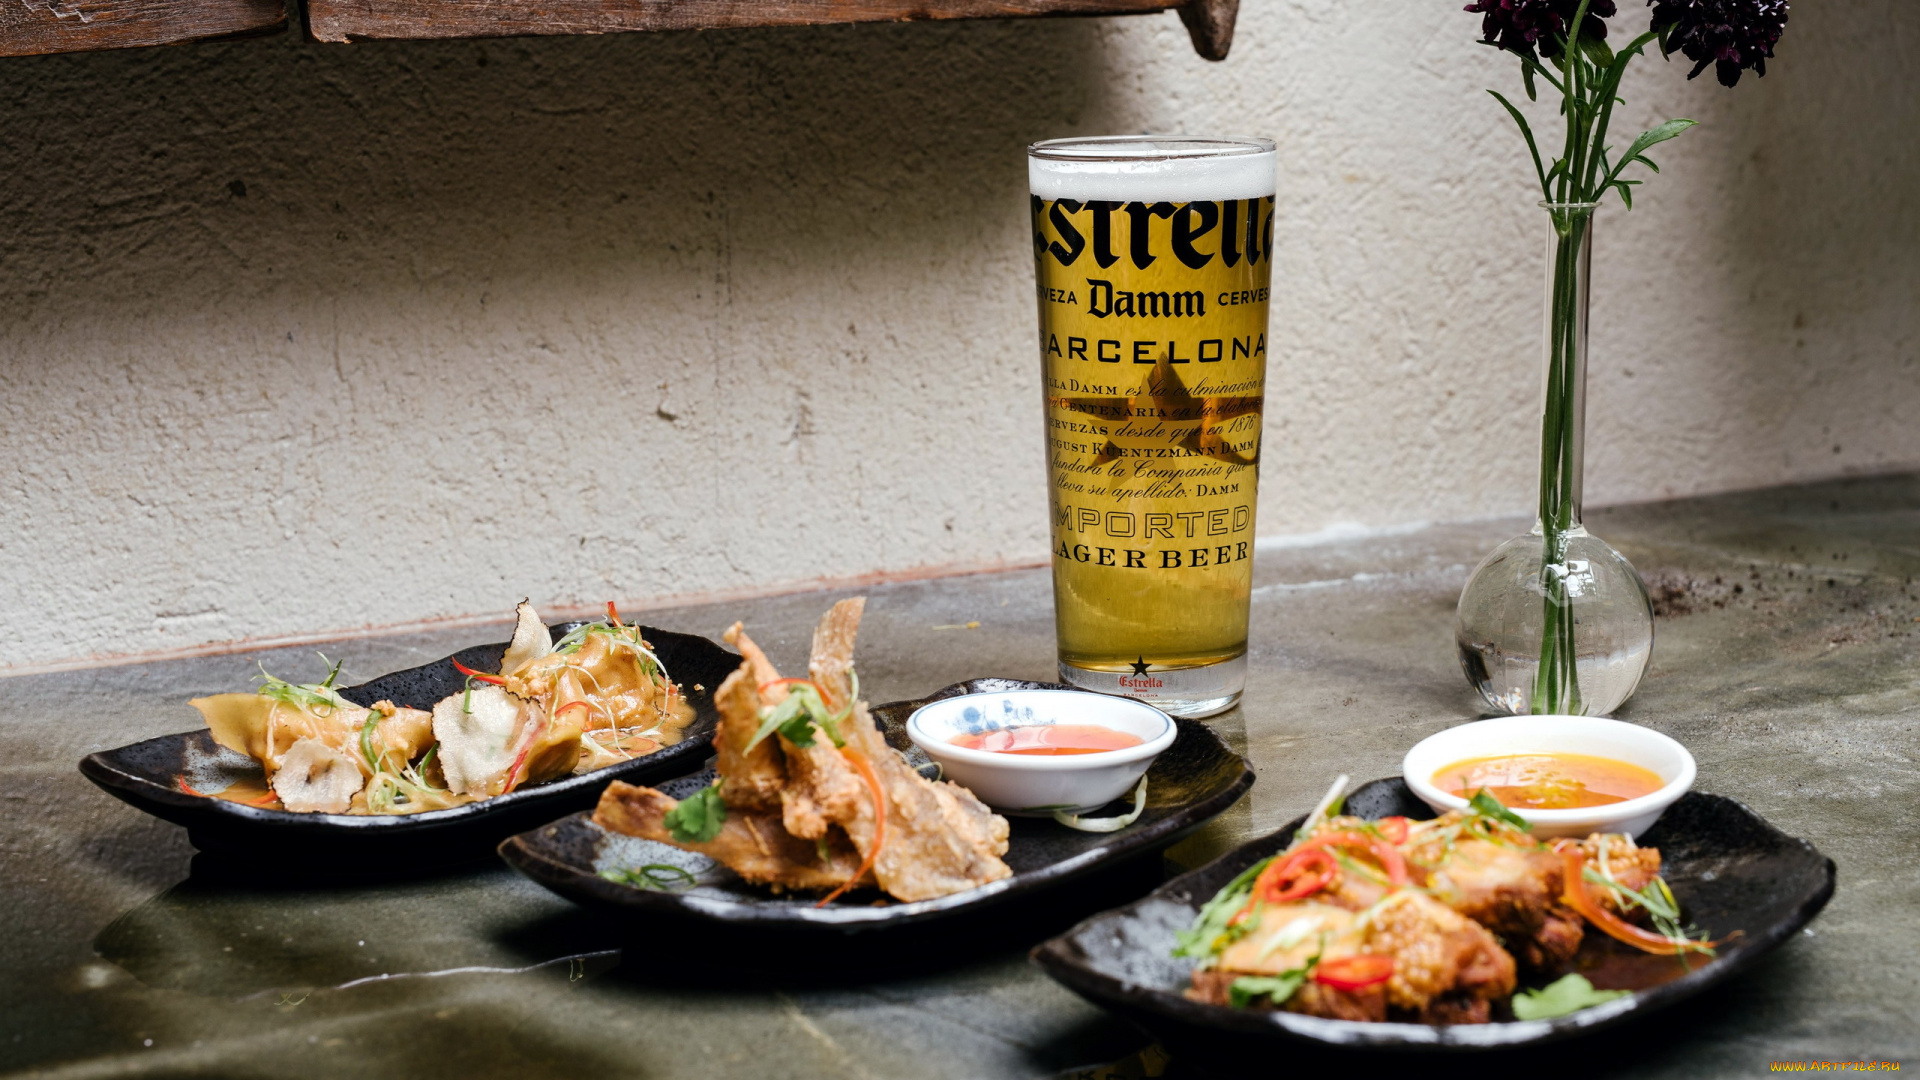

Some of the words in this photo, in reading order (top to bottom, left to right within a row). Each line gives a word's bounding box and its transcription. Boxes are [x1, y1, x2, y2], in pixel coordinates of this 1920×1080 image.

[1086, 277, 1206, 318] Damm
[1217, 286, 1271, 306] CERVES
[1069, 378, 1118, 395] DAMM
[1125, 386, 1142, 396] es
[1148, 378, 1168, 397] la
[1173, 376, 1257, 397] culminación
[1060, 398, 1168, 418] CENTENARIA
[1172, 407, 1188, 418] en
[1196, 398, 1213, 417] la
[1048, 417, 1108, 435] ERVEZAS
[1115, 421, 1166, 438] desde
[1168, 427, 1203, 443] que
[1207, 426, 1224, 436] en
[1229, 413, 1257, 433] 1876
[1050, 438, 1088, 453] UGUST
[1092, 442, 1216, 458] KUENTZMANN
[1221, 440, 1254, 455] DAMM
[1052, 451, 1103, 477] fundara
[1107, 459, 1126, 478] la
[1133, 459, 1224, 484] Compañía
[1056, 473, 1084, 494] lleva
[1088, 485, 1108, 496] su
[1197, 483, 1240, 497] DAMM
[1052, 501, 1250, 539] MPORTED
[1051, 534, 1148, 569] LAGER
[1158, 541, 1248, 569] BEER
[1119, 675, 1163, 688] Estrella
